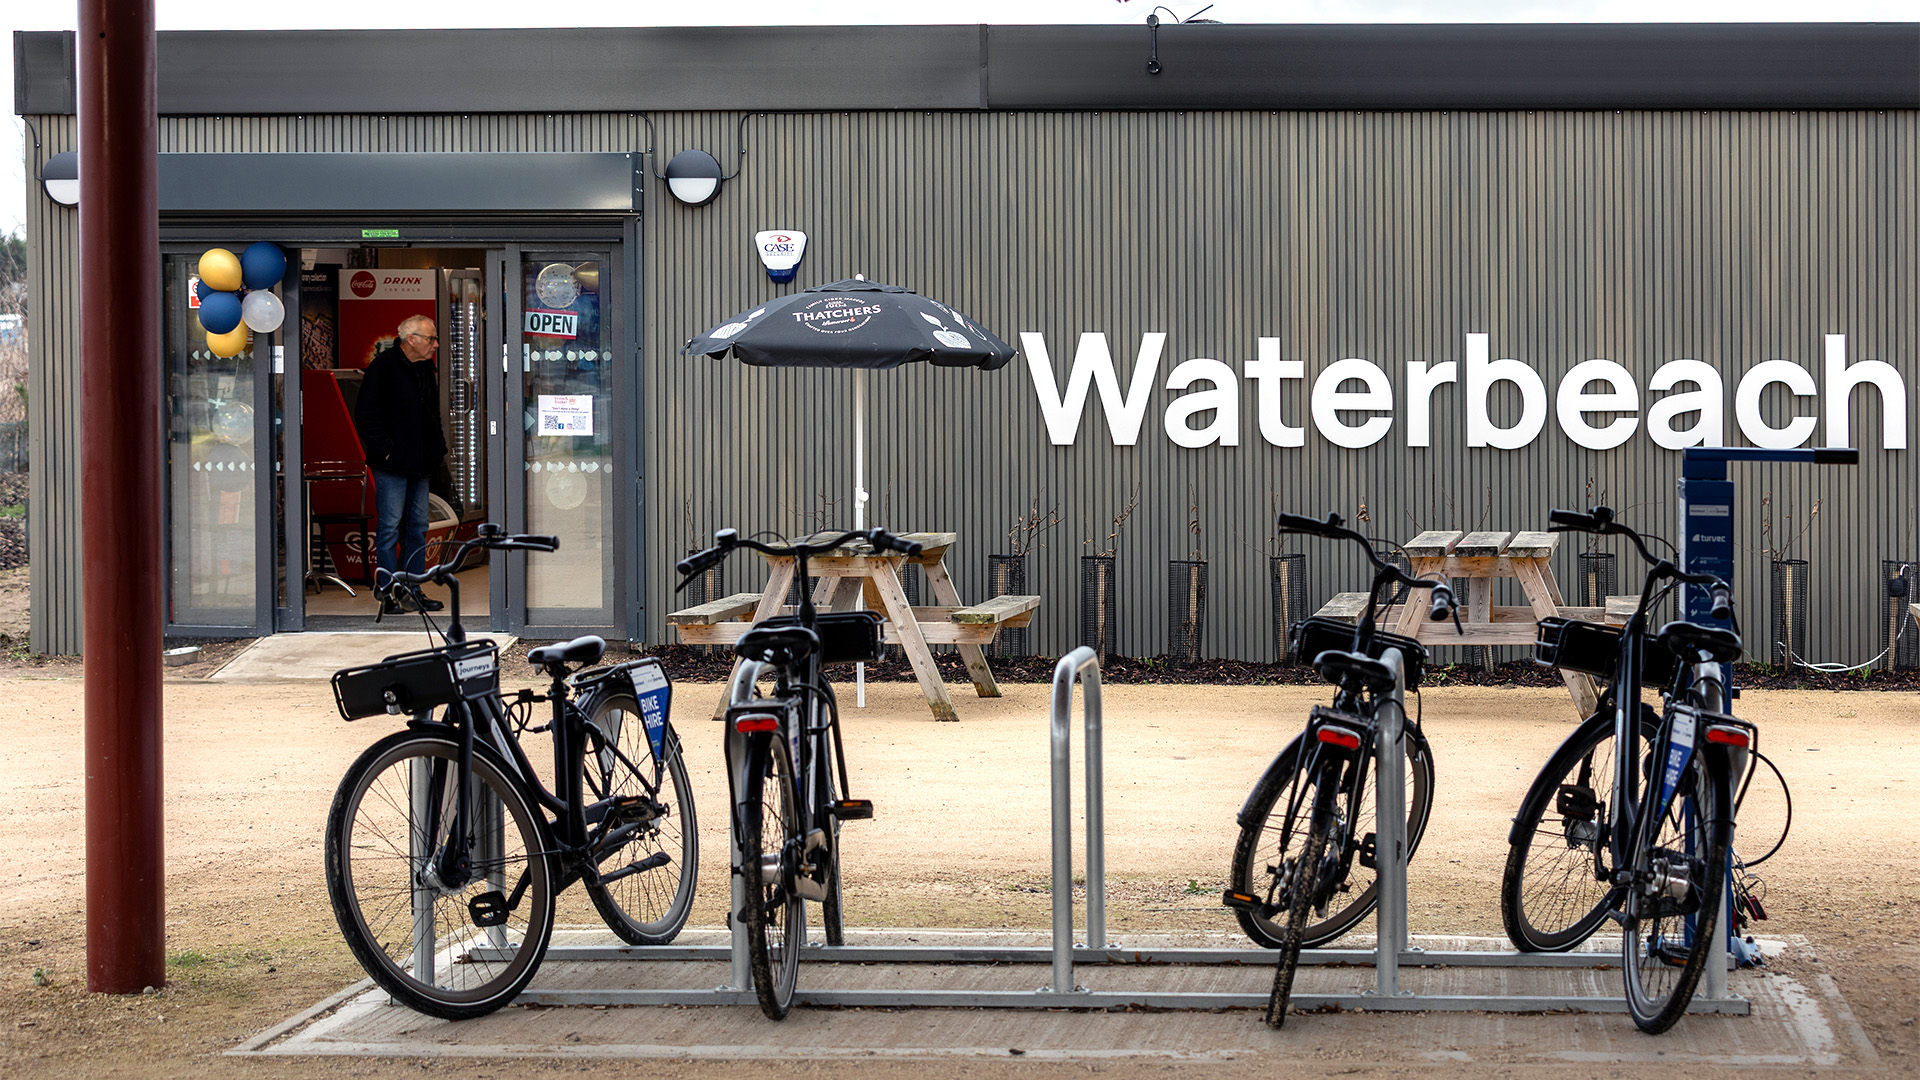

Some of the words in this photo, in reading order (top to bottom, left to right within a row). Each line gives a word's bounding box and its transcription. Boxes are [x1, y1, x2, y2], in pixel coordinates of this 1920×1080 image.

[764, 243, 794, 252] CASE
[383, 276, 422, 285] DRINK
[792, 304, 882, 322] THATCHERS
[530, 313, 573, 334] OPEN
[1019, 331, 1908, 450] Waterbeach
[1700, 534, 1726, 542] turvec
[346, 554, 378, 564] WAL'S
[459, 662, 490, 676] journeys
[640, 695, 660, 714] BIKE
[644, 711, 664, 730] HIRE
